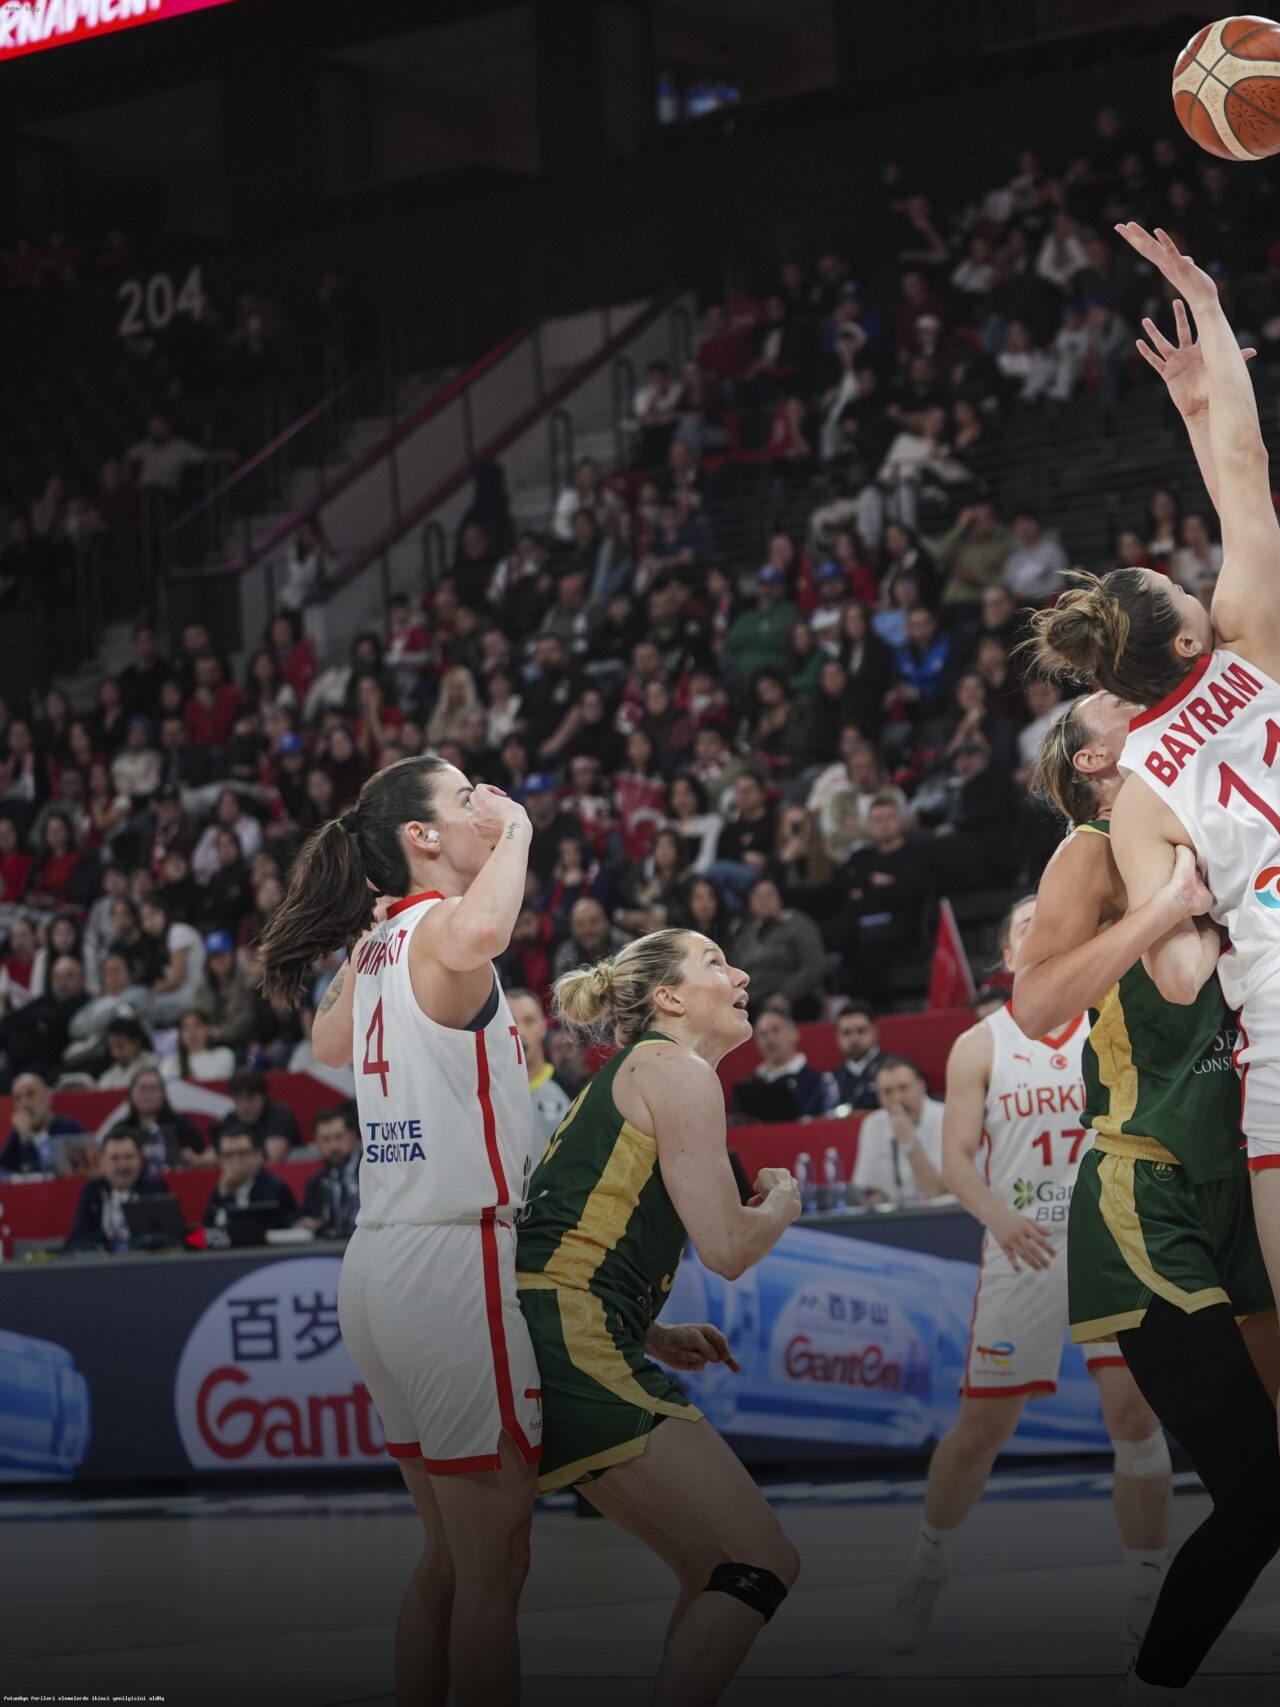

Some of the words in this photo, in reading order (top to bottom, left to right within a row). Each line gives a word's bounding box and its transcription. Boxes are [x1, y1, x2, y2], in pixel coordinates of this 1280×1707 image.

[118, 266, 208, 335] 204
[1144, 662, 1264, 787] BAYRAM
[363, 996, 389, 1097] 4
[1032, 1128, 1087, 1166] 17
